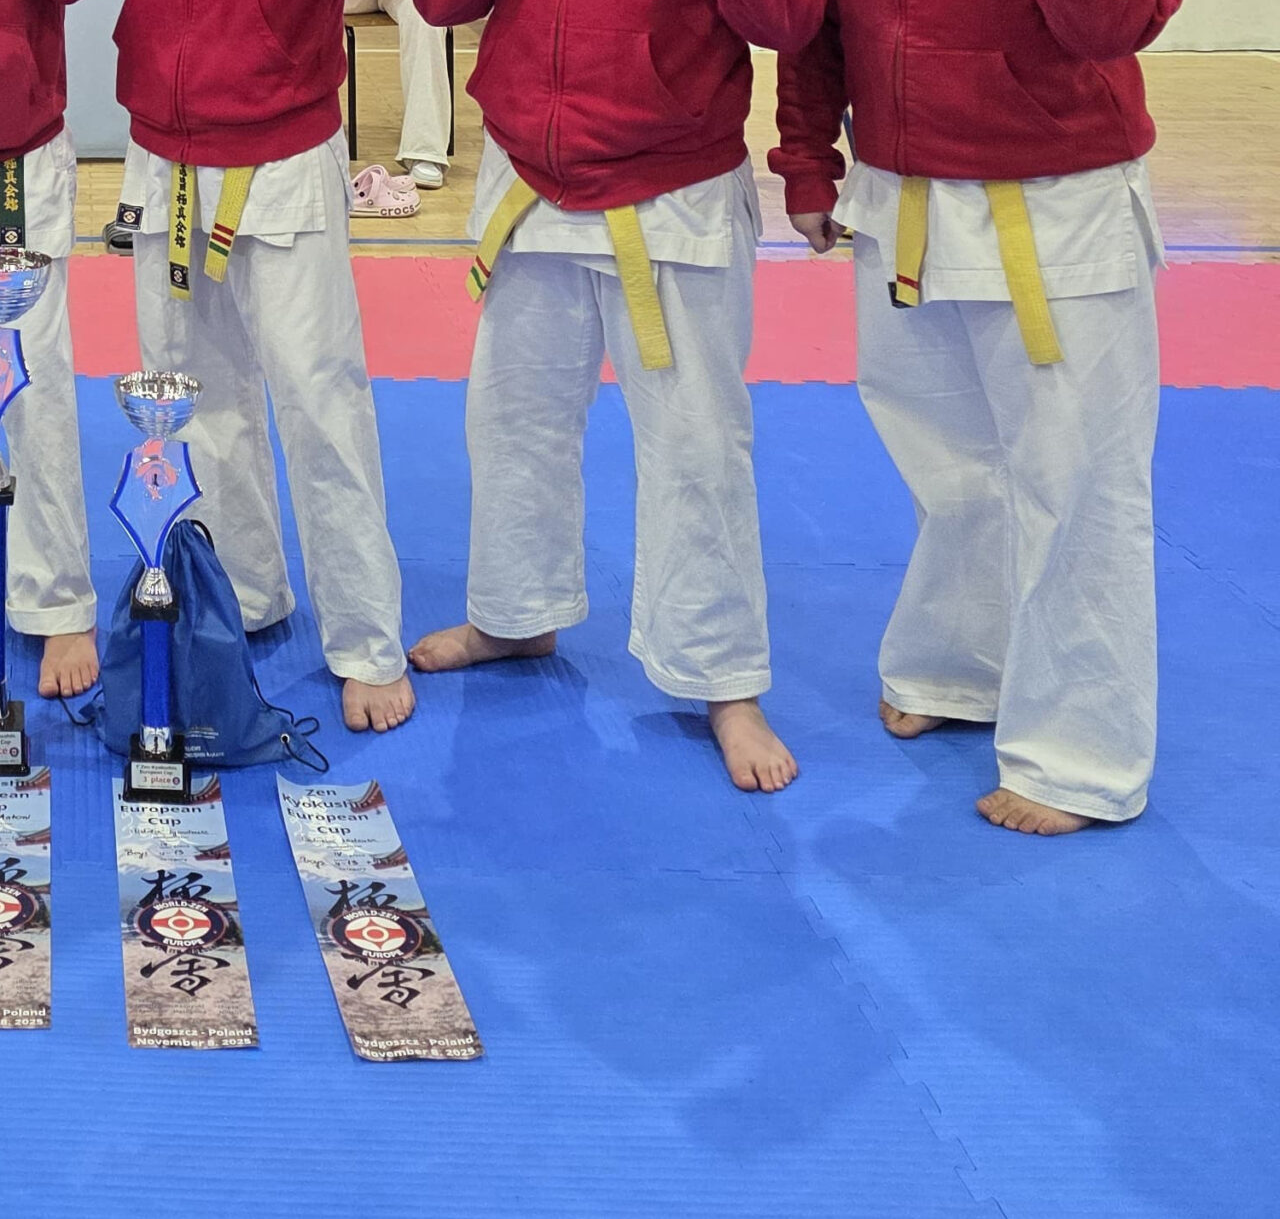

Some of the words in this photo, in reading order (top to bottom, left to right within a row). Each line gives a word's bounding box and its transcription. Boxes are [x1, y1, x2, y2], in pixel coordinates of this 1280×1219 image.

[380, 204, 415, 216] crocs
[305, 788, 337, 797] Zen
[120, 805, 202, 815] European
[286, 807, 369, 823] European
[148, 817, 182, 827] Cup
[316, 825, 352, 836] Cup
[163, 937, 204, 948] EUROPE
[361, 948, 405, 960] EUROPE
[3, 1007, 46, 1017] Poland
[14, 1018, 44, 1026] 2025
[133, 1026, 198, 1037] Bydgoszcz
[208, 1027, 253, 1037] Poland
[136, 1037, 204, 1047] November
[221, 1038, 252, 1046] 2025
[354, 1035, 420, 1050] Bydgoszcz
[428, 1033, 474, 1046] Poland
[360, 1047, 429, 1058] November
[444, 1046, 476, 1057] 2025
